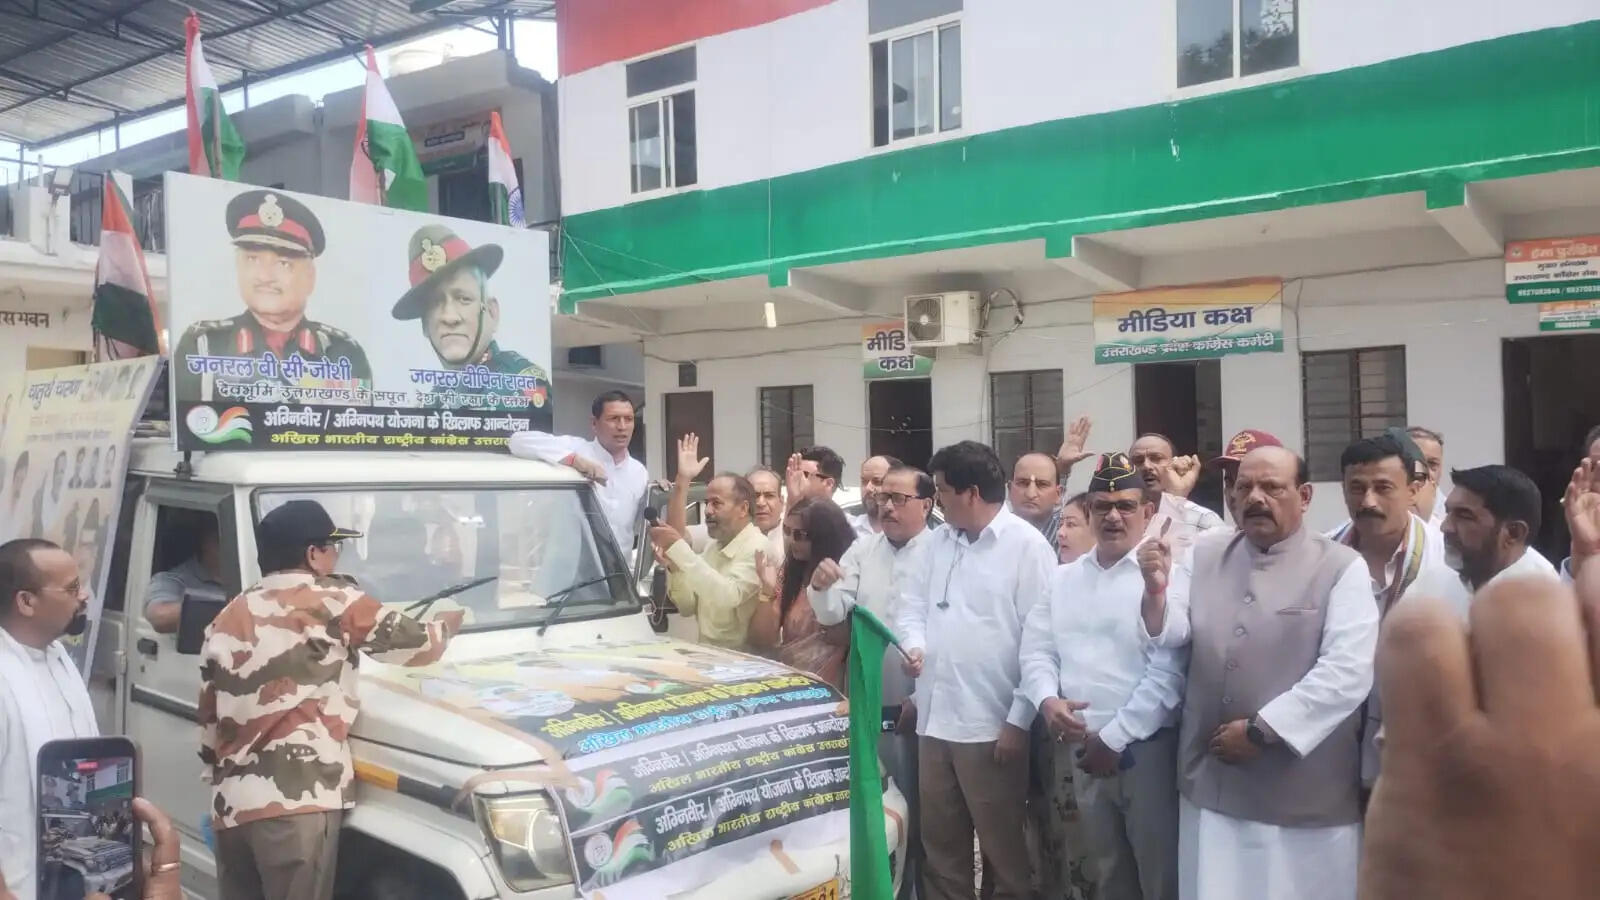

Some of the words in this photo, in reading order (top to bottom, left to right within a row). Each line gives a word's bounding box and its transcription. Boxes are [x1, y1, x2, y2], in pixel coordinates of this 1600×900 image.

[1117, 308, 1196, 333] मीडिया
[1203, 306, 1254, 326] कक्ष
[866, 329, 906, 351] मीडि
[1236, 331, 1275, 348] कमेटी
[186, 355, 255, 376] जनरल
[258, 352, 278, 378] बी
[307, 354, 352, 381] जोशी
[879, 354, 915, 371] कक्ष
[409, 368, 460, 388] जनरल
[503, 373, 537, 392] रावत
[217, 380, 273, 399] देवभूमि
[281, 385, 350, 401] उत्तराखण्ड
[356, 385, 371, 401] के
[416, 390, 436, 406] देश
[439, 389, 456, 406] की
[459, 393, 485, 407] रक्षा
[486, 391, 500, 408] के
[264, 406, 322, 427] अग्निवीर
[333, 408, 385, 429] अग्निपथ
[387, 409, 426, 429] योजना
[427, 411, 442, 430] के
[442, 411, 482, 431] खिलाफ
[483, 413, 531, 431] आन्दोलन
[271, 430, 320, 444] अखिल
[324, 431, 380, 446] भारतीय
[383, 433, 426, 447] राष्ट्रीय
[542, 712, 612, 738] अग्निवीर
[577, 728, 634, 754] अखिल
[631, 751, 685, 779] अग्निवीर
[690, 739, 737, 763] अग्निपथ
[735, 735, 771, 754] योजना
[769, 727, 783, 745] के
[777, 724, 817, 745] खिलाफ
[649, 774, 692, 794] अखिल
[696, 760, 742, 781] भारतीय
[745, 748, 781, 767] राष्ट्रीय
[655, 801, 709, 835] अग्निवीर
[717, 787, 760, 813] अग्निपथ
[759, 779, 794, 800] योजना
[792, 770, 805, 791] के
[802, 767, 834, 789] खिलाफ
[668, 825, 714, 851] अखिल
[718, 812, 761, 833] भारतीय
[765, 801, 800, 819] राष्ट्रीय
